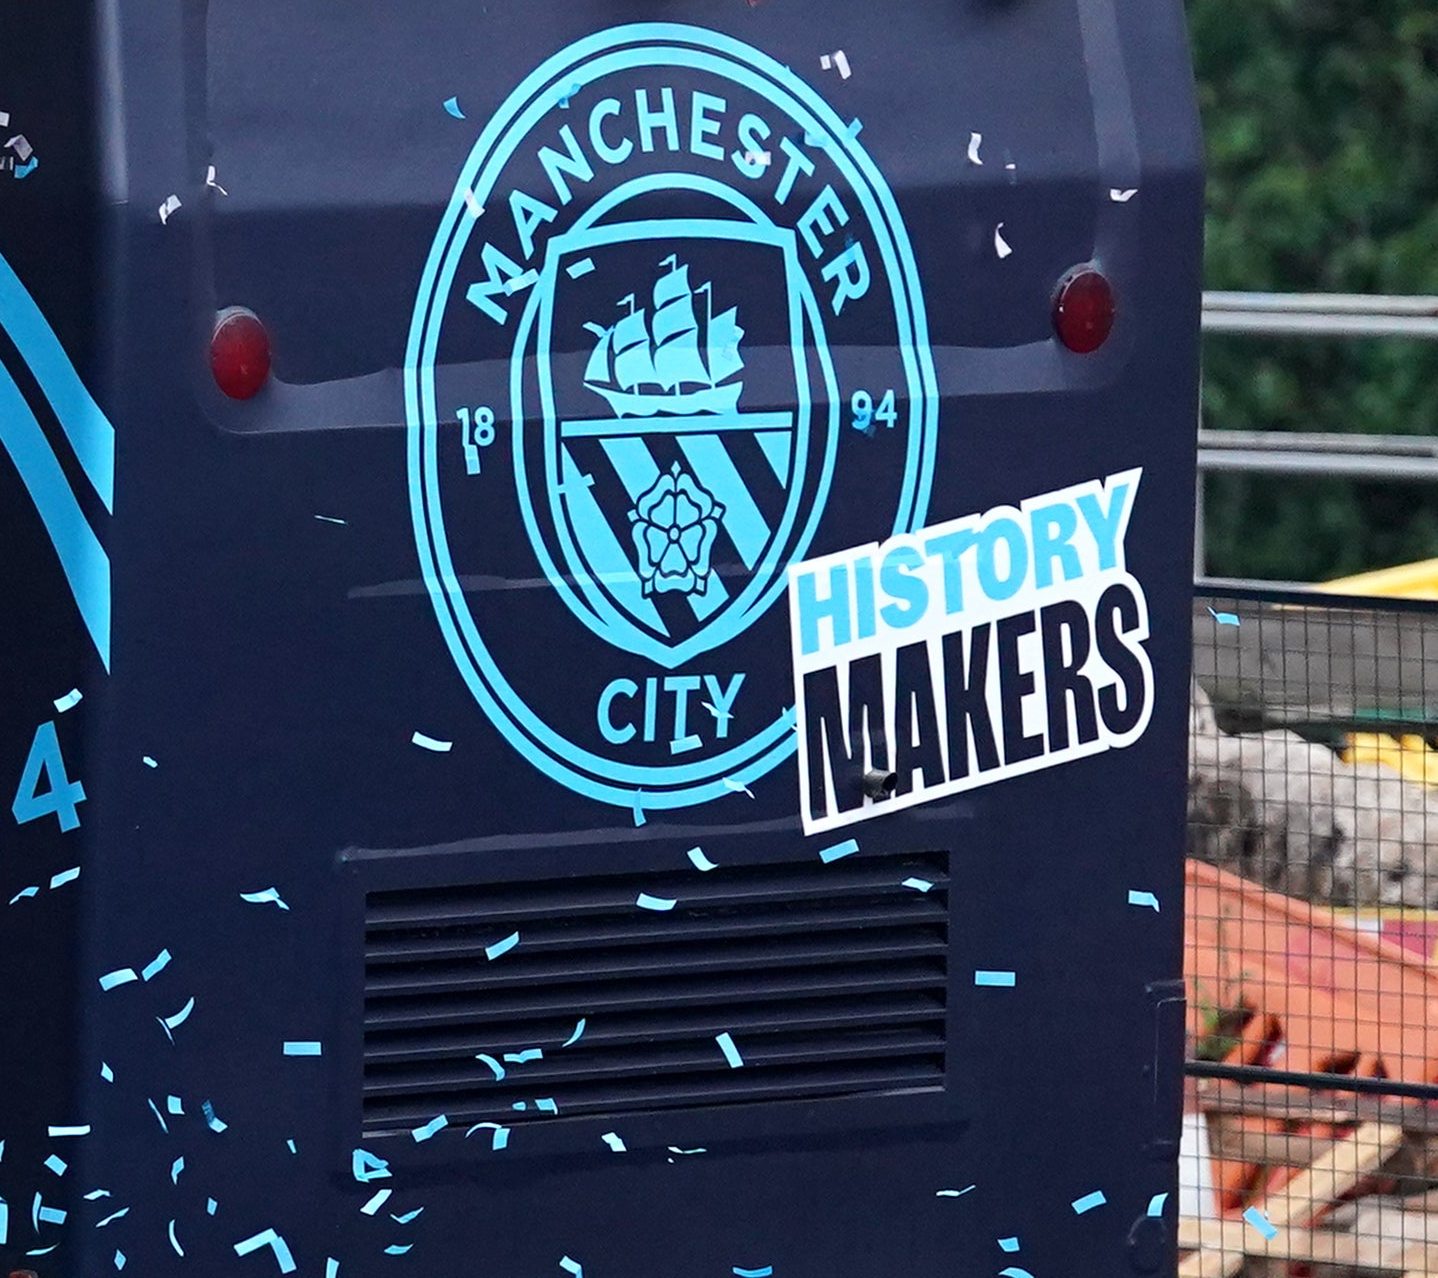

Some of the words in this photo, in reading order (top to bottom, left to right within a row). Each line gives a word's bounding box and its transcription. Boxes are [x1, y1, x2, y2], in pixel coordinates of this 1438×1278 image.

[466, 86, 872, 325] MANCHESTER
[456, 406, 495, 448] 18
[850, 389, 898, 430] 94
[797, 483, 1130, 656] HISTORY
[597, 672, 746, 744] CITY
[802, 583, 1145, 822] MAKERS
